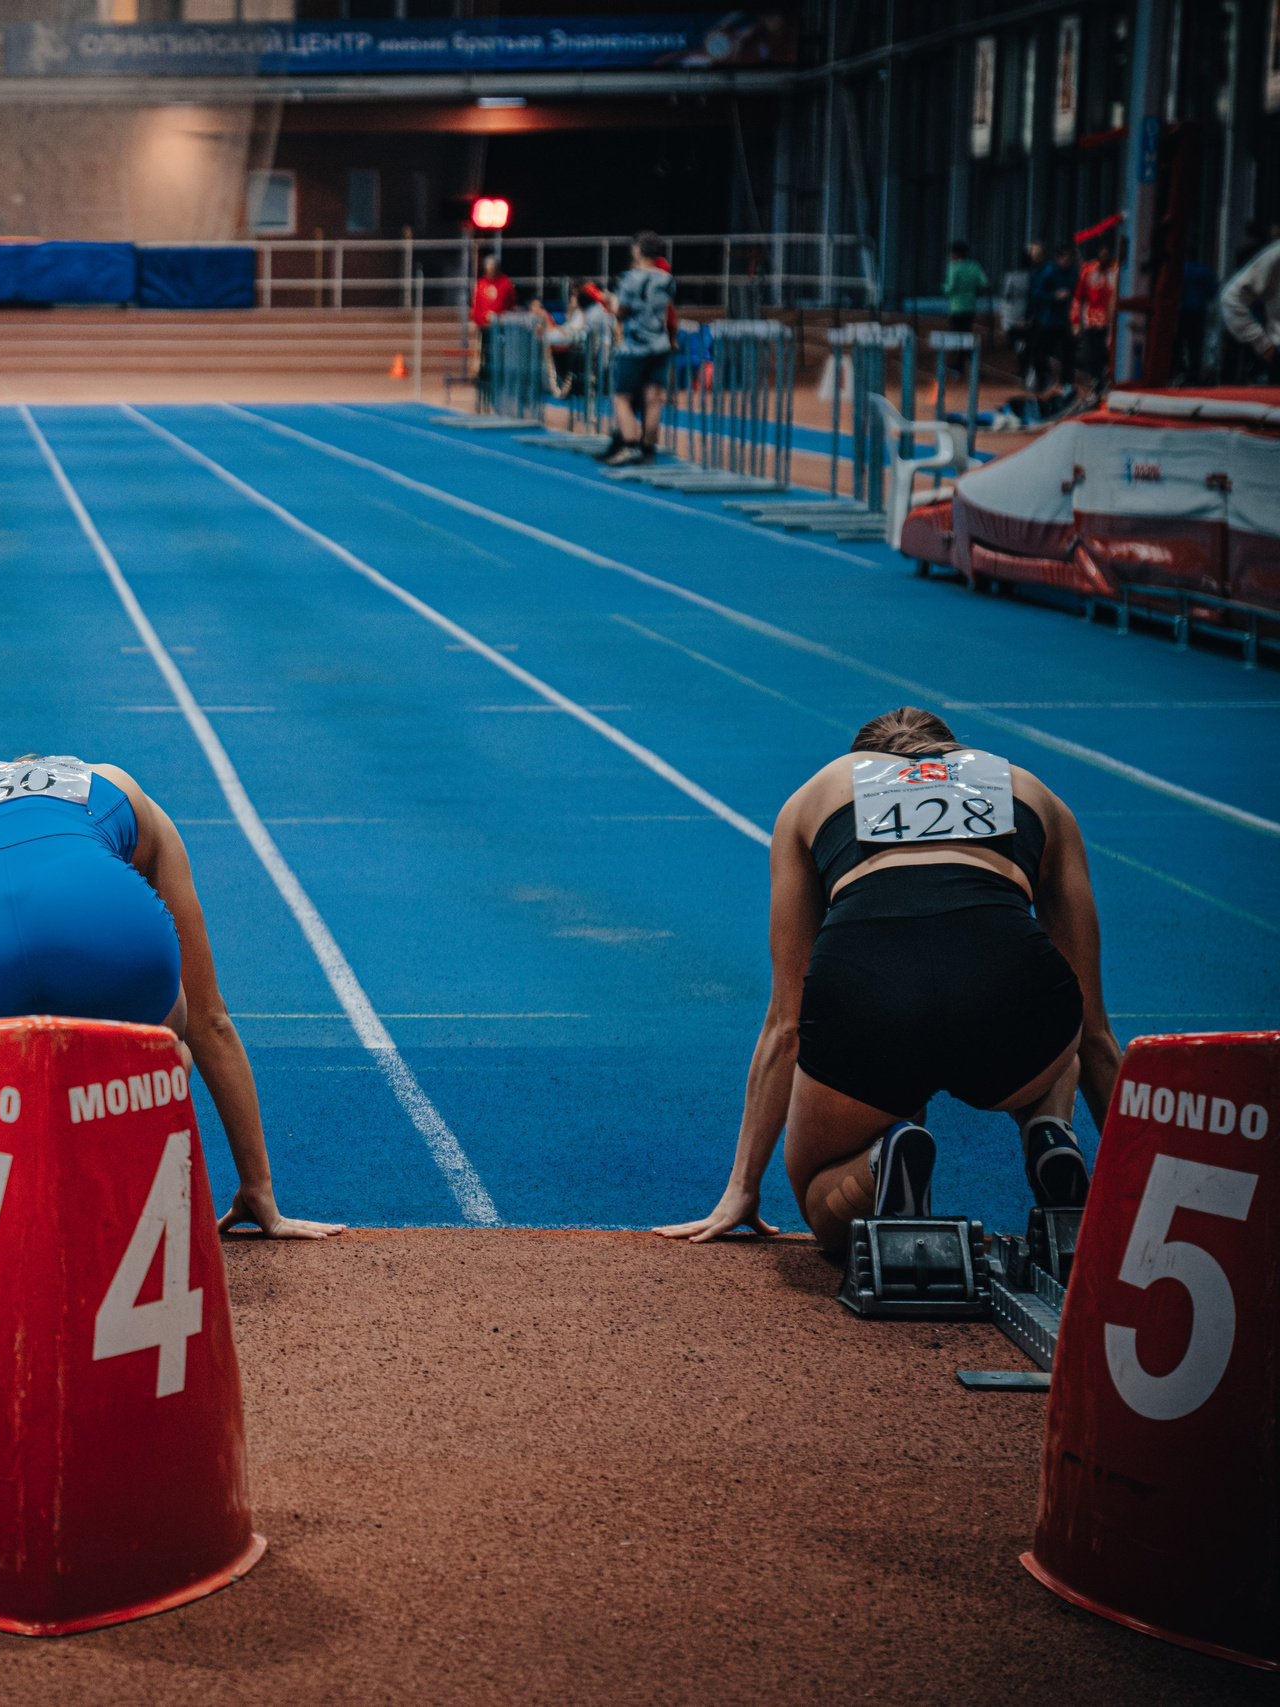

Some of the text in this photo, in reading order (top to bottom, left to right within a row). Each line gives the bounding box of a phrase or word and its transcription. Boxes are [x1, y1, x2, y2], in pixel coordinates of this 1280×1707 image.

[289, 31, 373, 57] ЦЕНТР
[871, 797, 997, 840] 428
[68, 1065, 188, 1123] MONDO
[1120, 1079, 1268, 1140] MONDO
[92, 1129, 203, 1398] 4
[1104, 1152, 1259, 1421] 5
